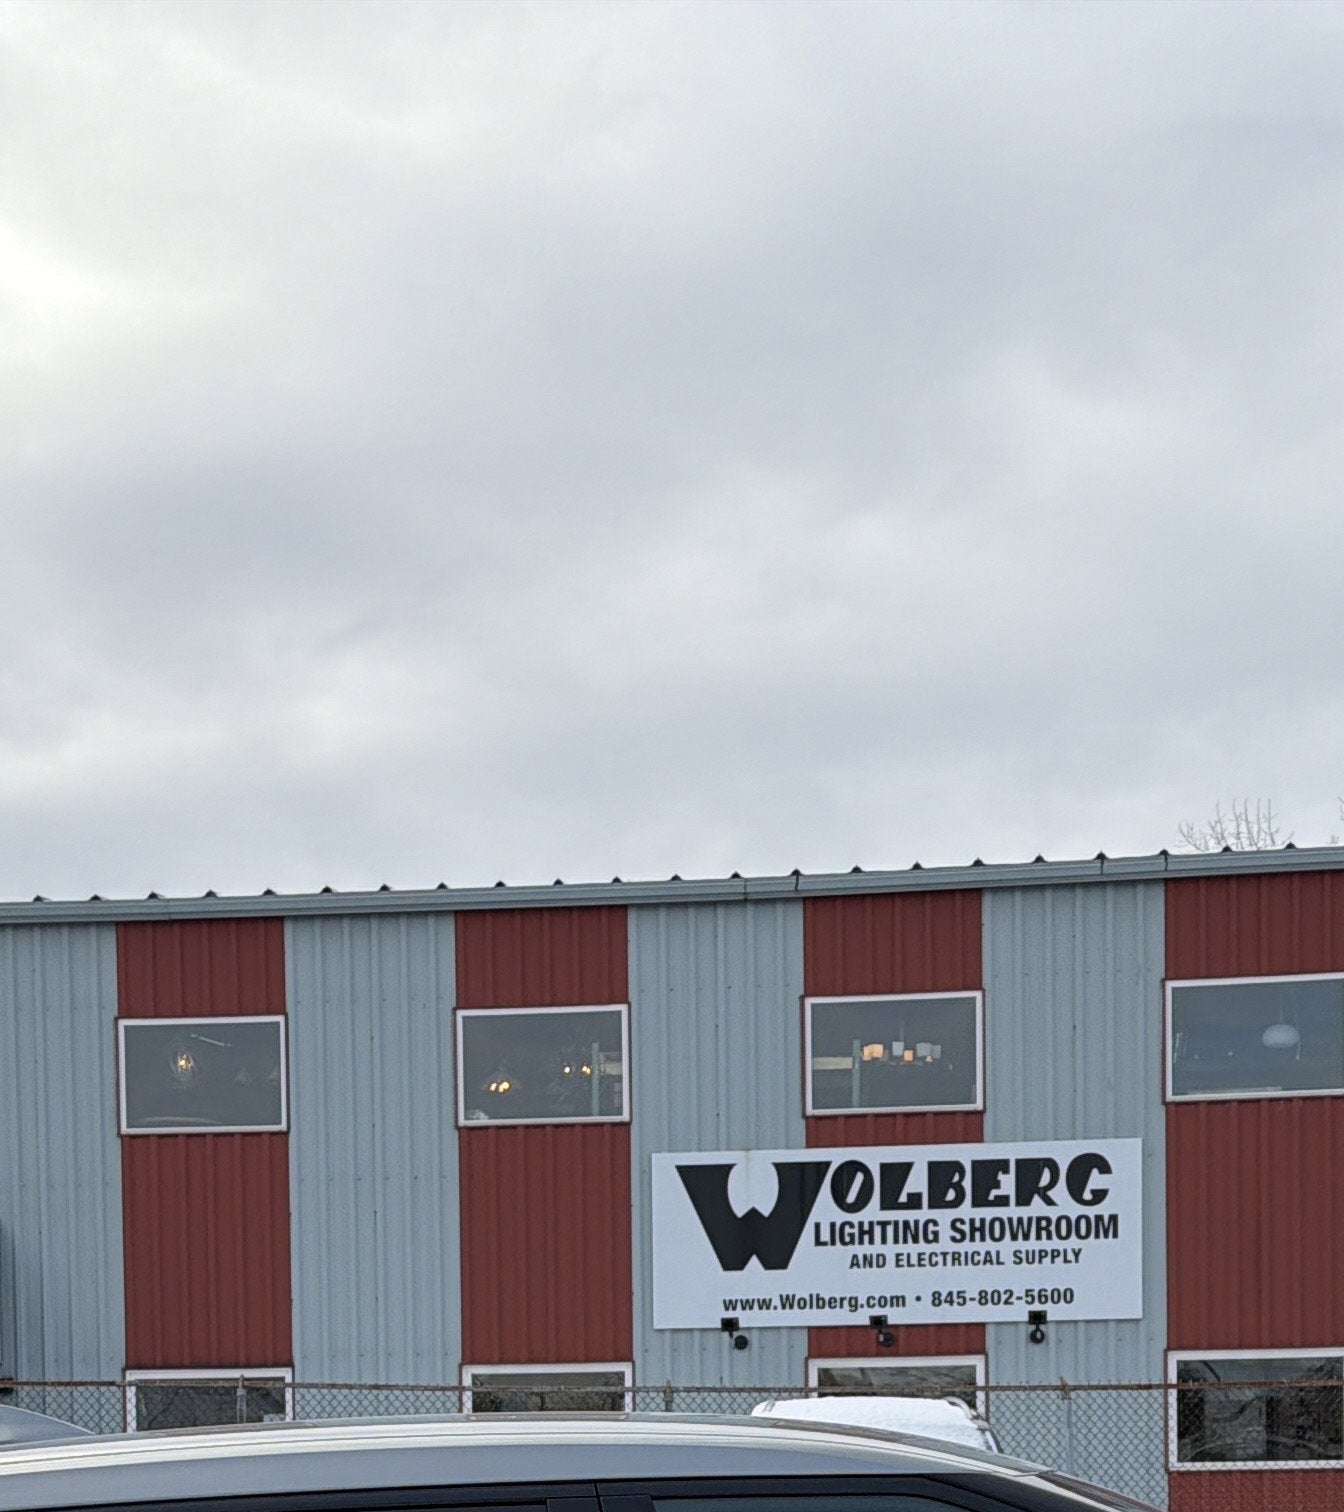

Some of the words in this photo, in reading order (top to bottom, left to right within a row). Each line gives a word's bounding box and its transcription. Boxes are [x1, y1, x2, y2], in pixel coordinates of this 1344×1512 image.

[674, 1152, 1113, 1271] WOLBERG
[813, 1218, 940, 1247] LIGHTING
[949, 1213, 1119, 1244] SHOWROOM
[849, 1252, 887, 1270] AND
[894, 1249, 1005, 1268] ELECTRICAL
[1012, 1247, 1083, 1265] SUPPLY
[722, 1292, 906, 1313] www.Wolberg.com
[930, 1287, 1075, 1308] 845-802-5600
